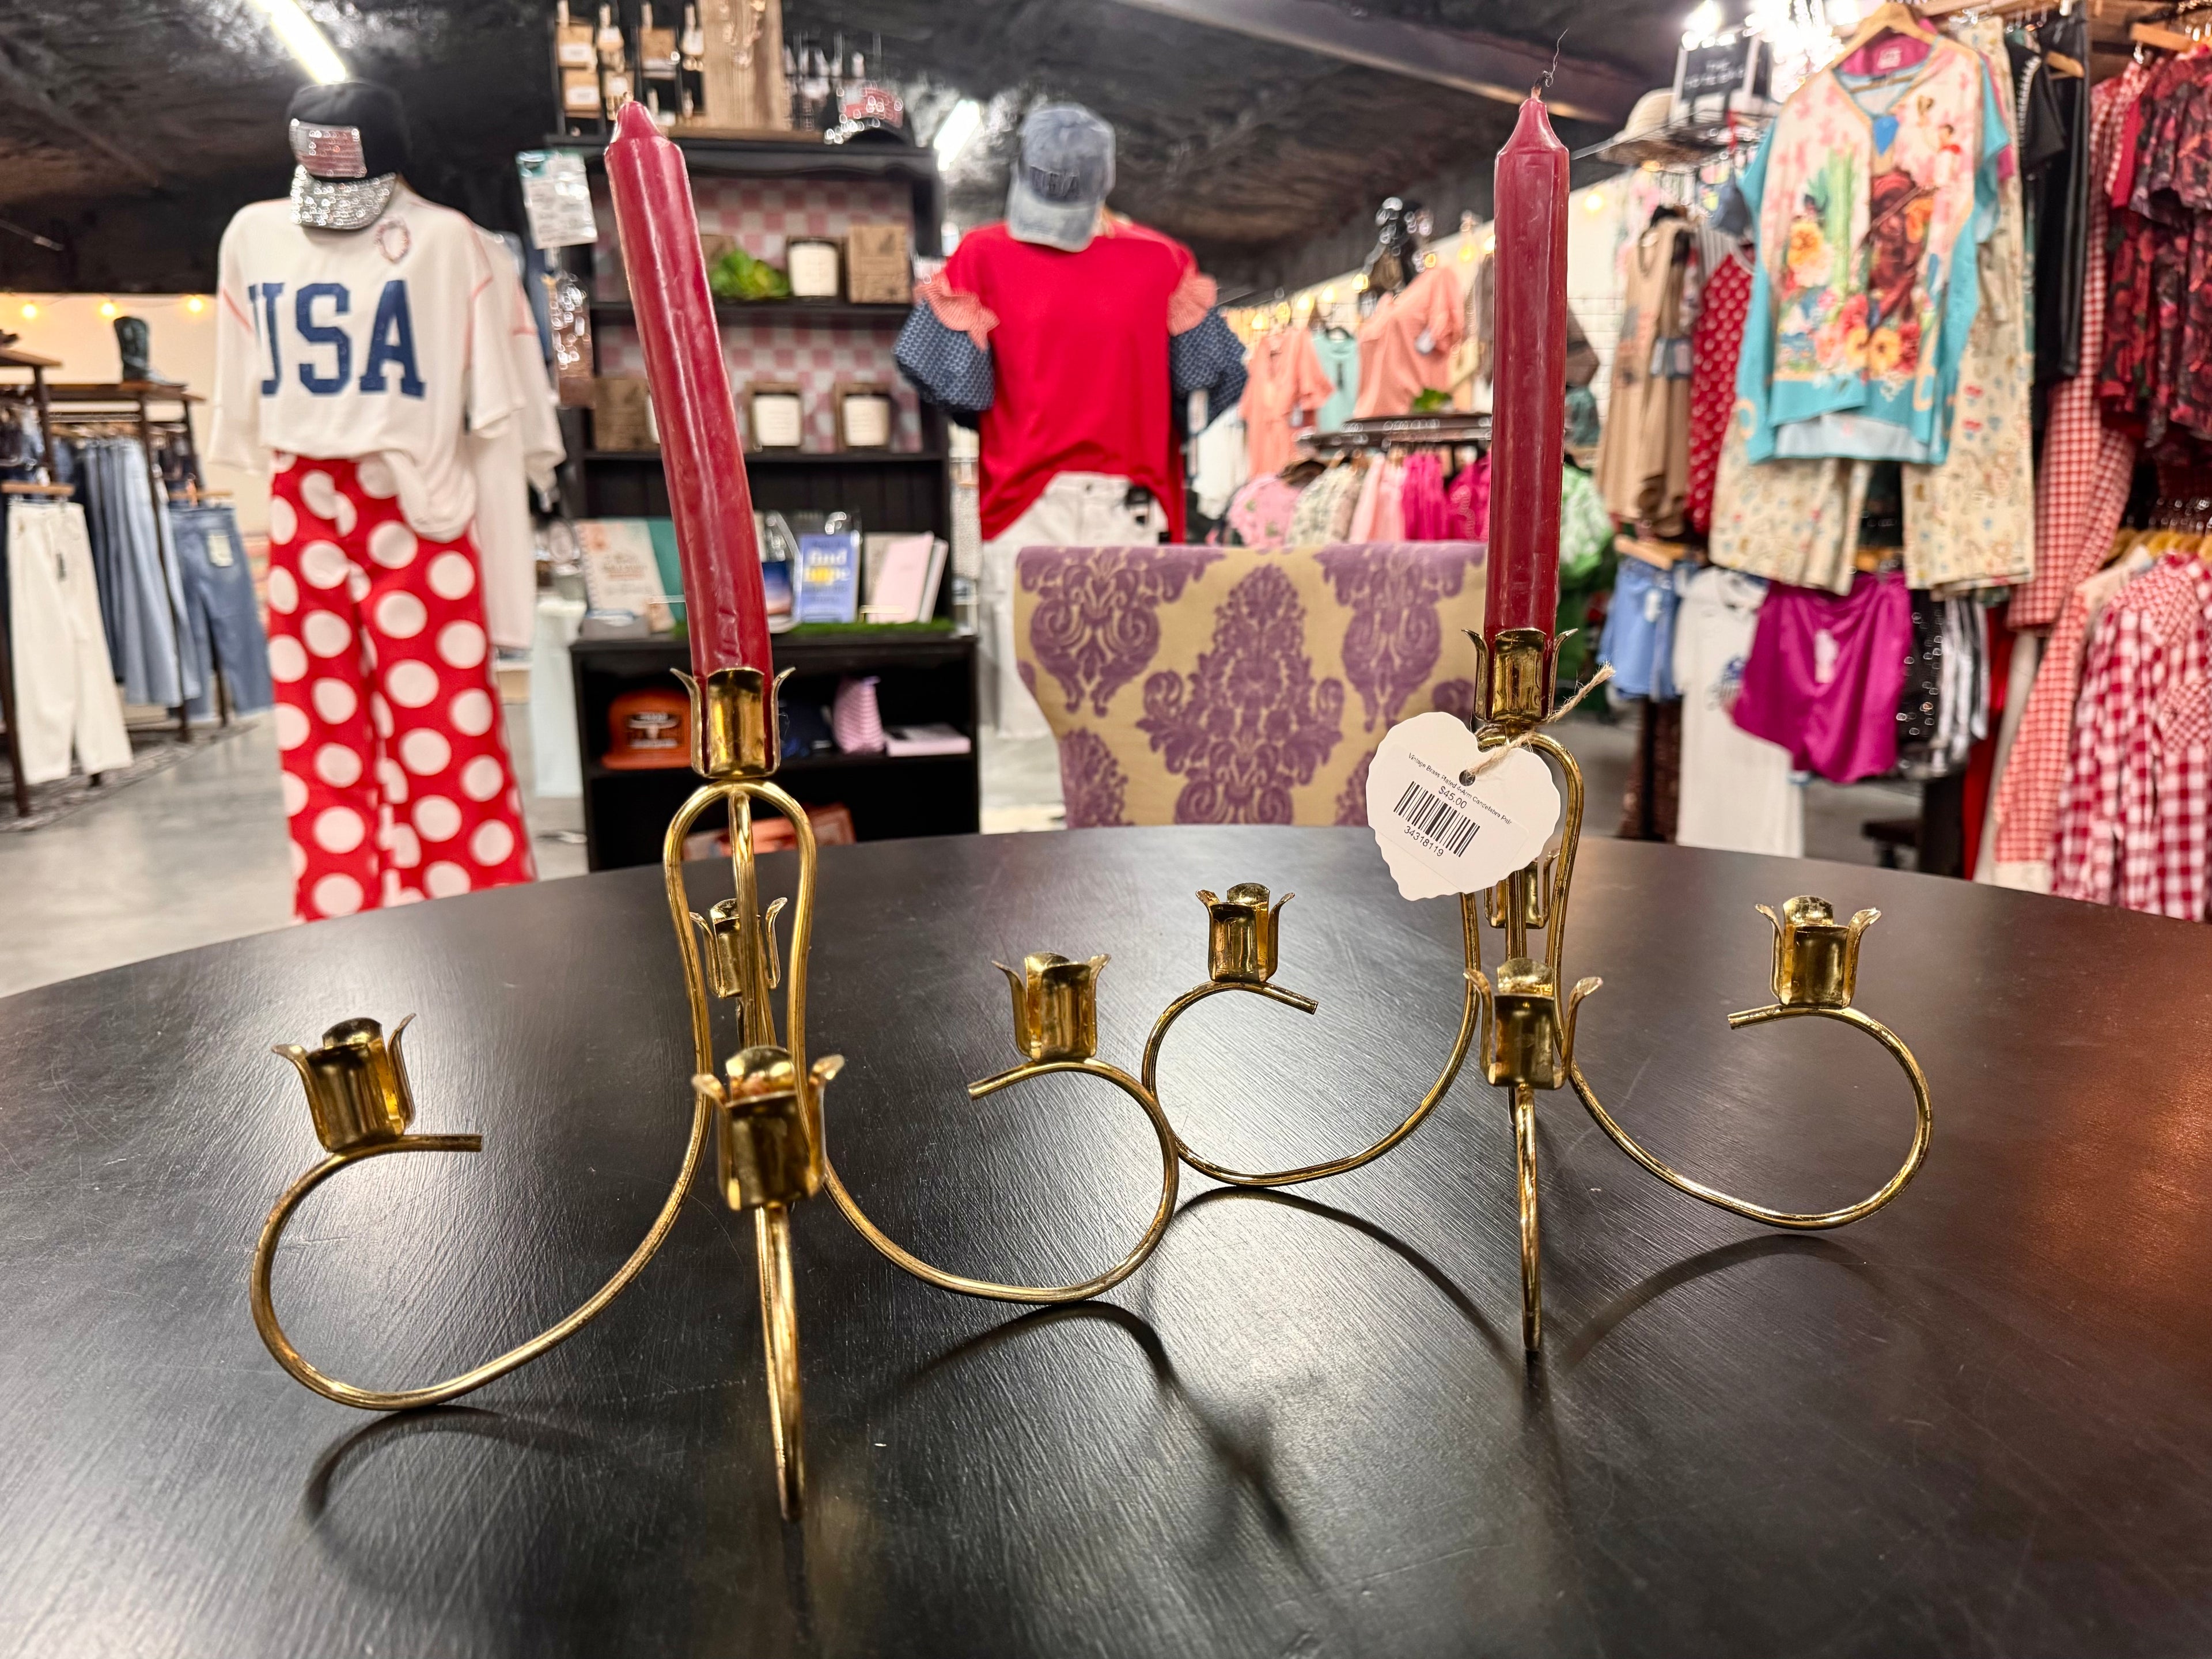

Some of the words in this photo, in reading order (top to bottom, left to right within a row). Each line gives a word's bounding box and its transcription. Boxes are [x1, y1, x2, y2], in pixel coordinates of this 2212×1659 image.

[248, 279, 426, 400] USA
[1408, 752, 1426, 768] Vintage
[1426, 765, 1440, 778] Brass
[1442, 775, 1457, 789] Plated
[1457, 786, 1472, 799] 4-Arm
[1472, 796, 1501, 817] Candelabra
[1501, 815, 1512, 825] Pair
[1438, 786, 1467, 809] $45.00
[1404, 825, 1444, 857] 34318119
